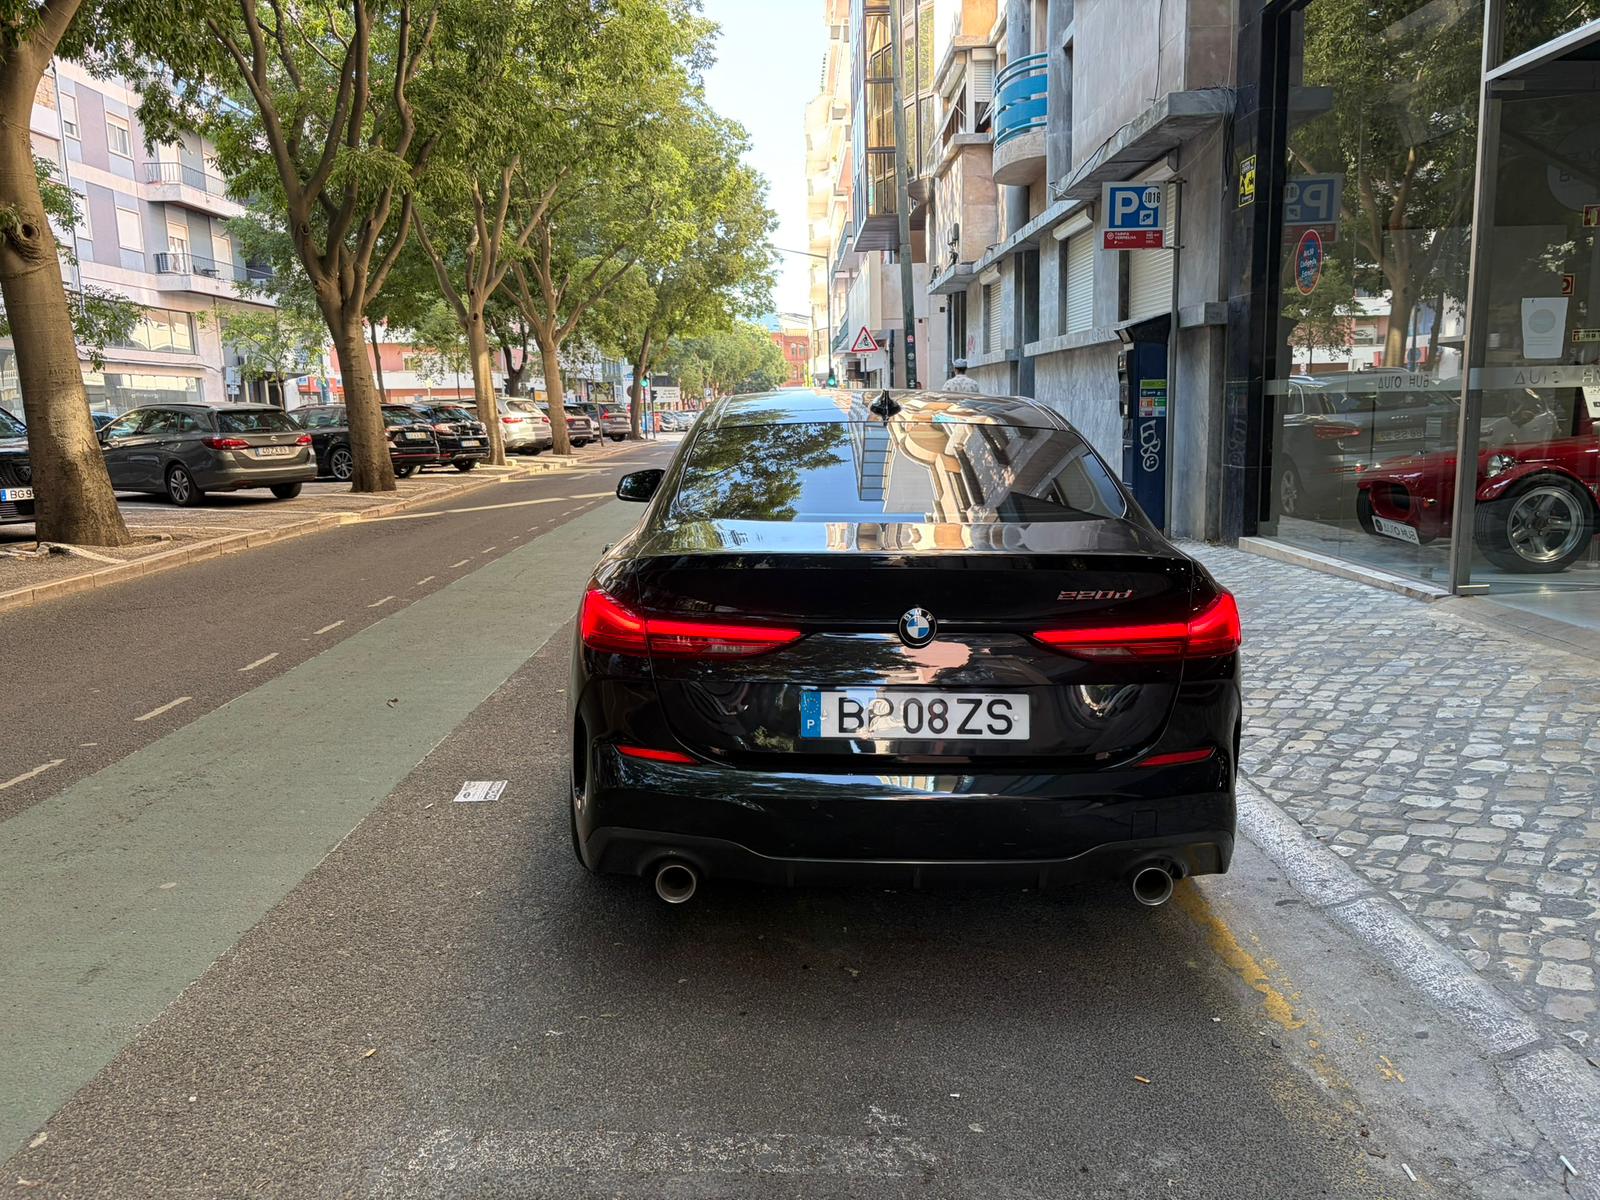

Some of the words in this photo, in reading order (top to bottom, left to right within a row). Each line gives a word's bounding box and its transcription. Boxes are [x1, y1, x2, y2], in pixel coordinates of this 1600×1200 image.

[1115, 190, 1140, 226] P
[1057, 589, 1134, 601] 220d
[902, 607, 934, 622] BMW
[806, 719, 816, 730] P
